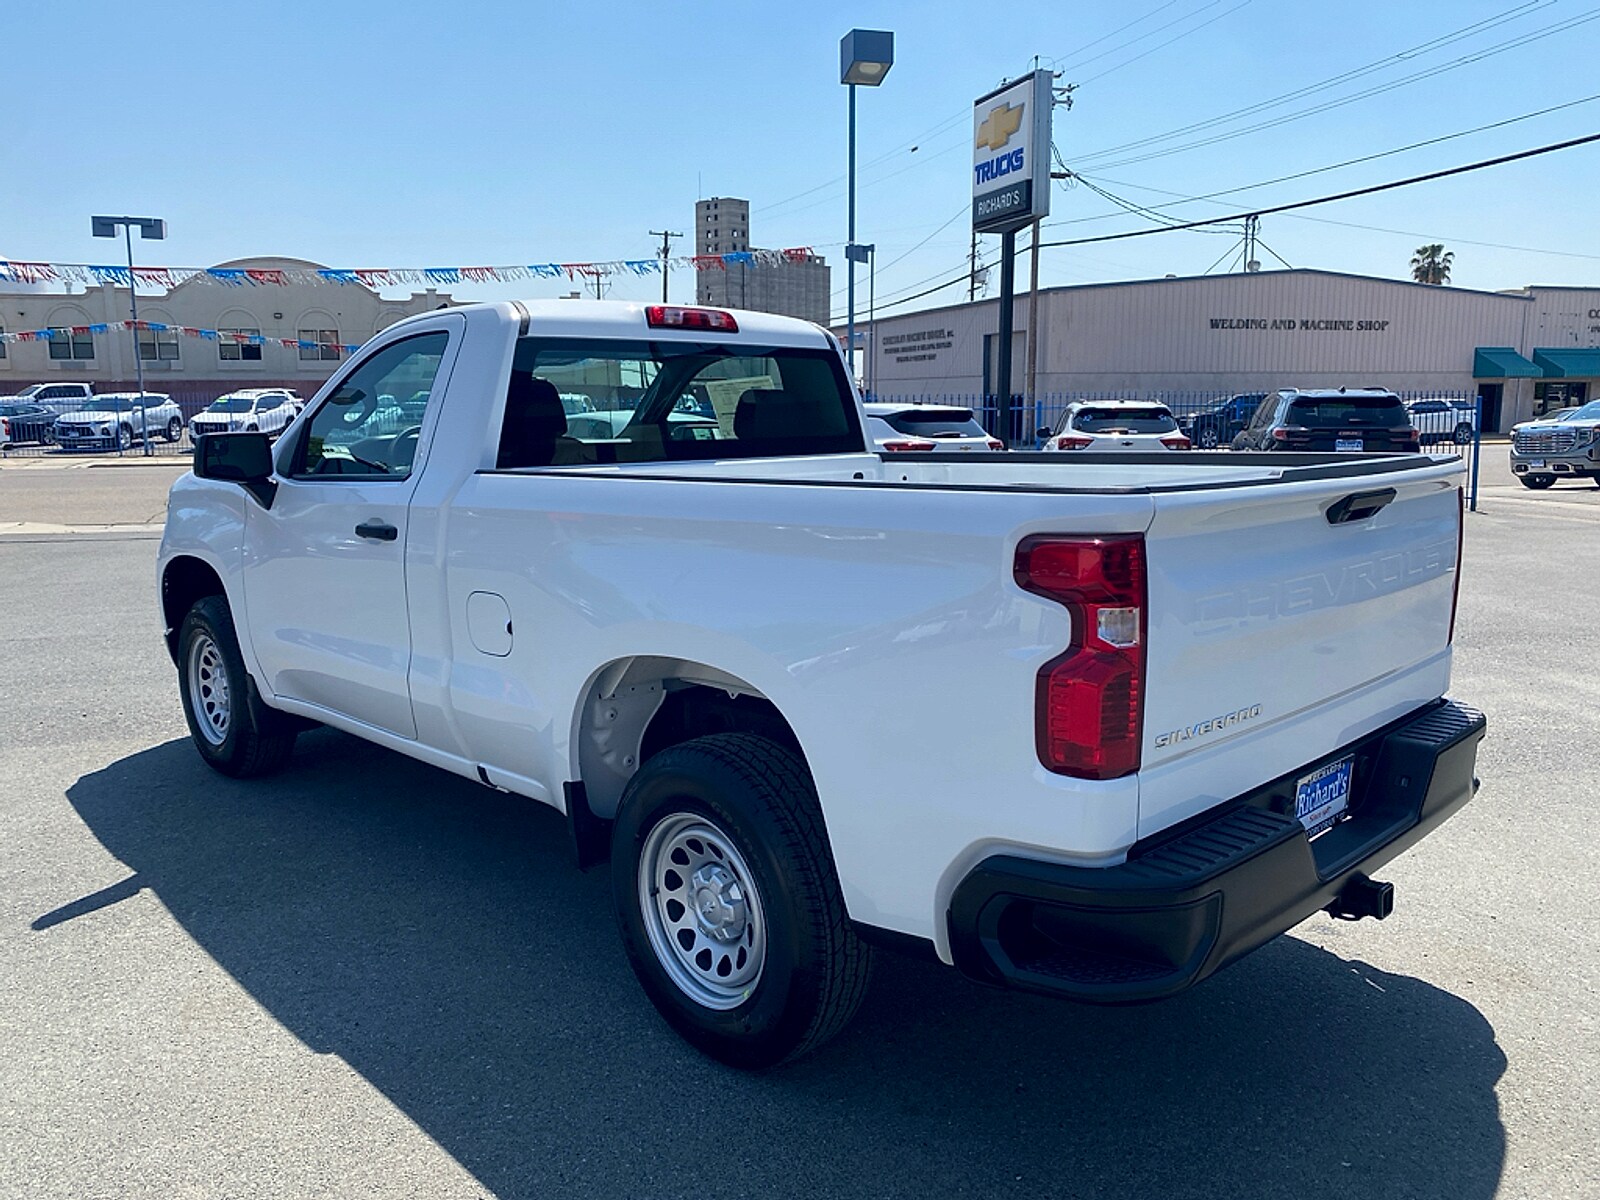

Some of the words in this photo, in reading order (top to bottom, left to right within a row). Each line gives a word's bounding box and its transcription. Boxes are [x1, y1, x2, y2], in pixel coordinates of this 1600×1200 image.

[974, 147, 1024, 185] TRUCKS
[977, 190, 1020, 216] RICHARD'S
[1209, 318, 1268, 330] WELDING
[1270, 318, 1297, 331] AND
[1299, 319, 1354, 331] MACHINE
[1356, 320, 1390, 332] SHOP
[1155, 703, 1263, 748] SILVERADO
[1297, 772, 1348, 819] Richard's
